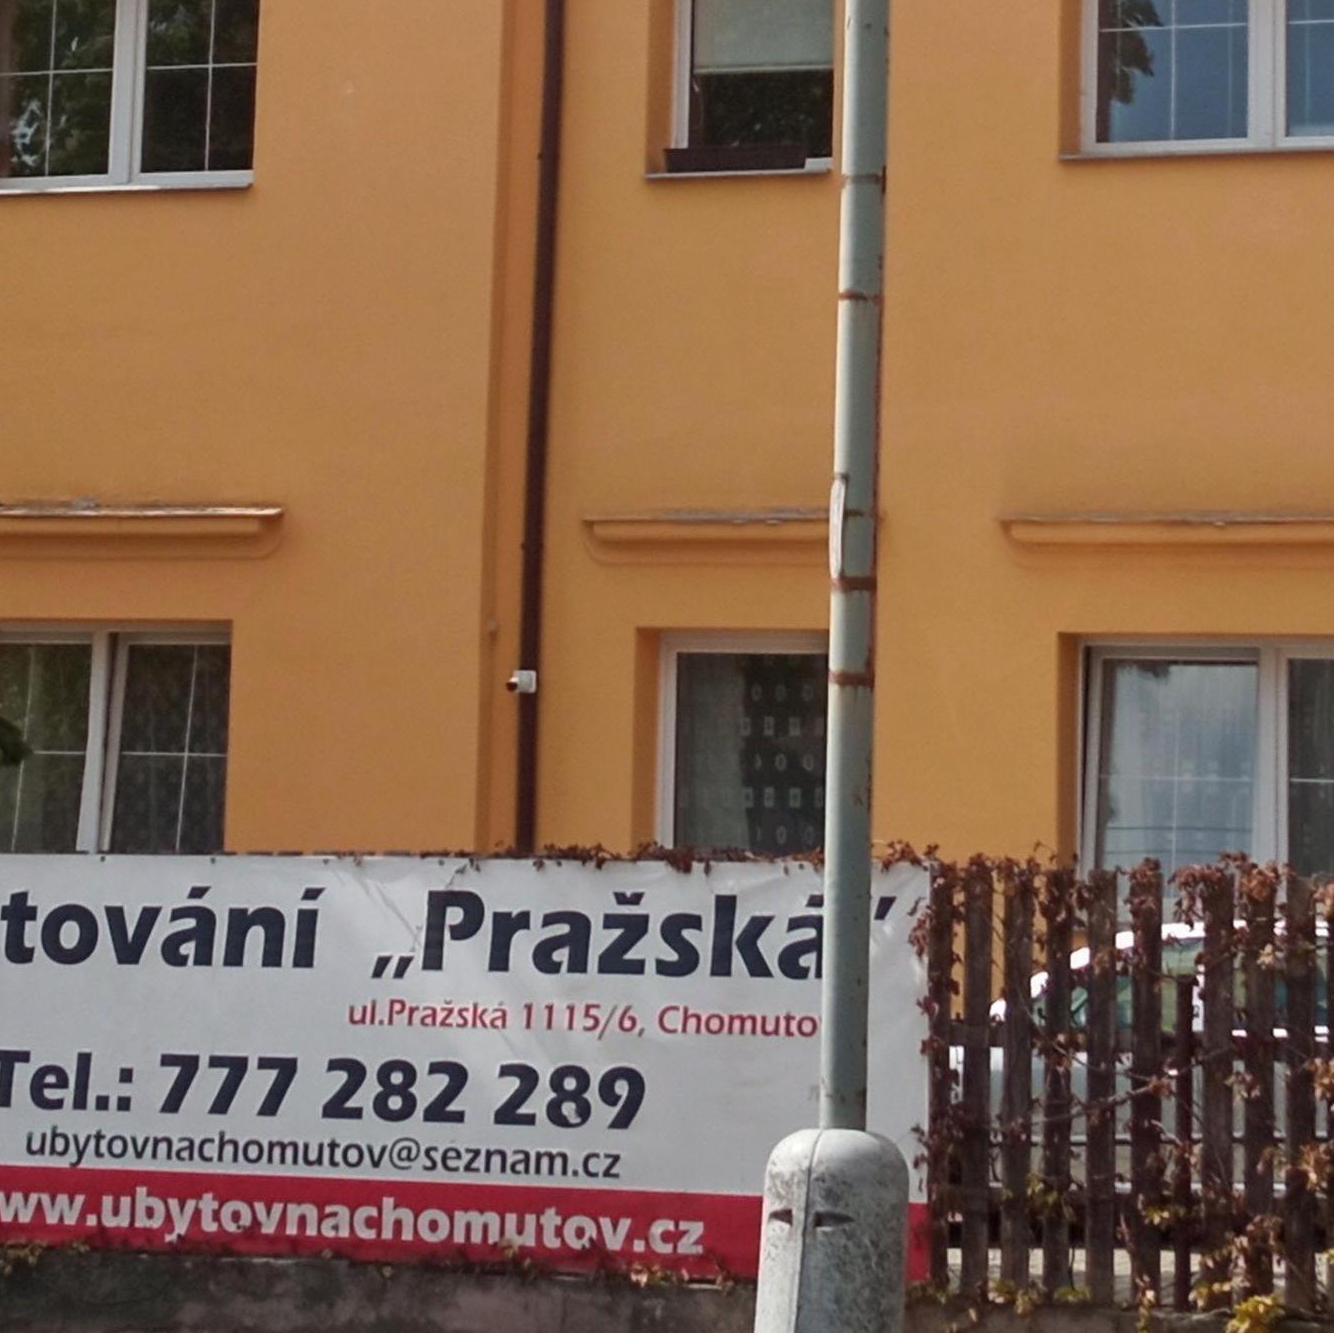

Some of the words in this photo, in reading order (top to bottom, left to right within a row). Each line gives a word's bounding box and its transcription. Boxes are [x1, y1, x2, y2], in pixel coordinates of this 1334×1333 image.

[521, 1001, 646, 1040] 1115/6,
[657, 1004, 823, 1039] Chomuto
[158, 1053, 299, 1117] 777
[321, 1057, 469, 1124] 282
[493, 1062, 647, 1130] 289
[24, 1124, 622, 1179] ubytovnachomutov@seznam.cz
